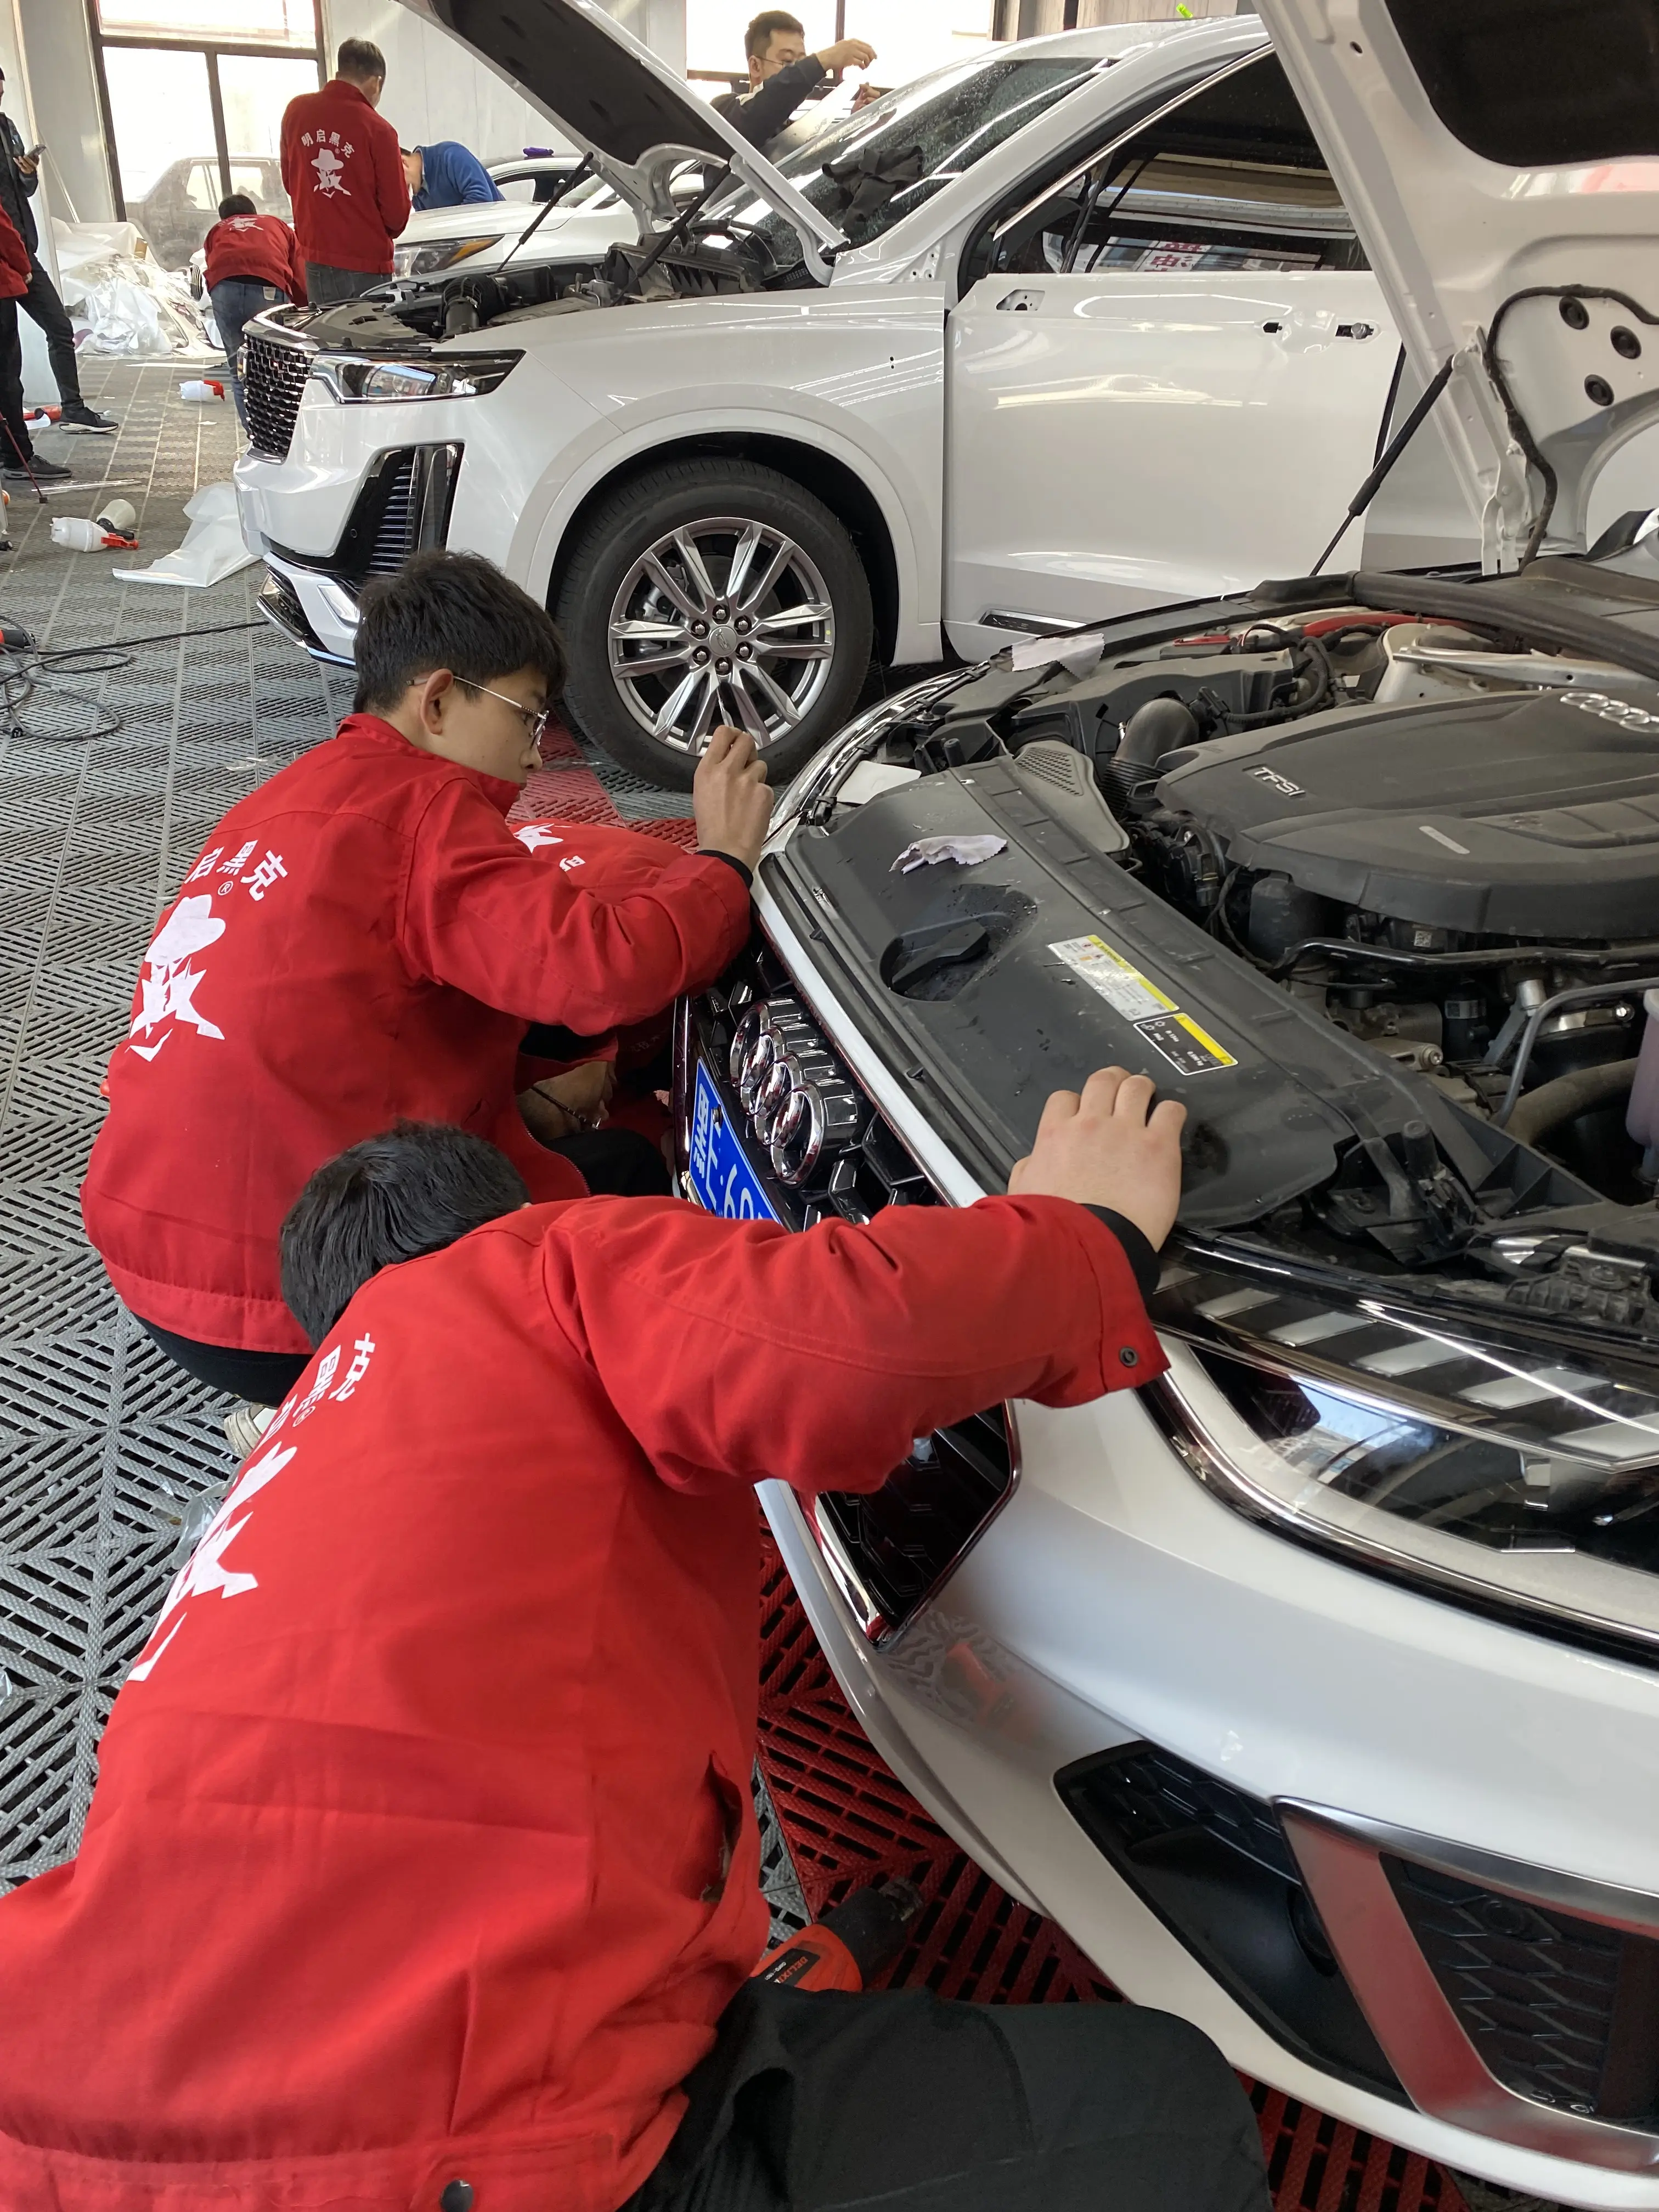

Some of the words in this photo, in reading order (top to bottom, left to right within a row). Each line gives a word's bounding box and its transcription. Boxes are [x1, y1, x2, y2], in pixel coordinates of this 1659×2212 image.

[301, 129, 355, 158] 明启黑克
[1254, 767, 1305, 796] TFSI
